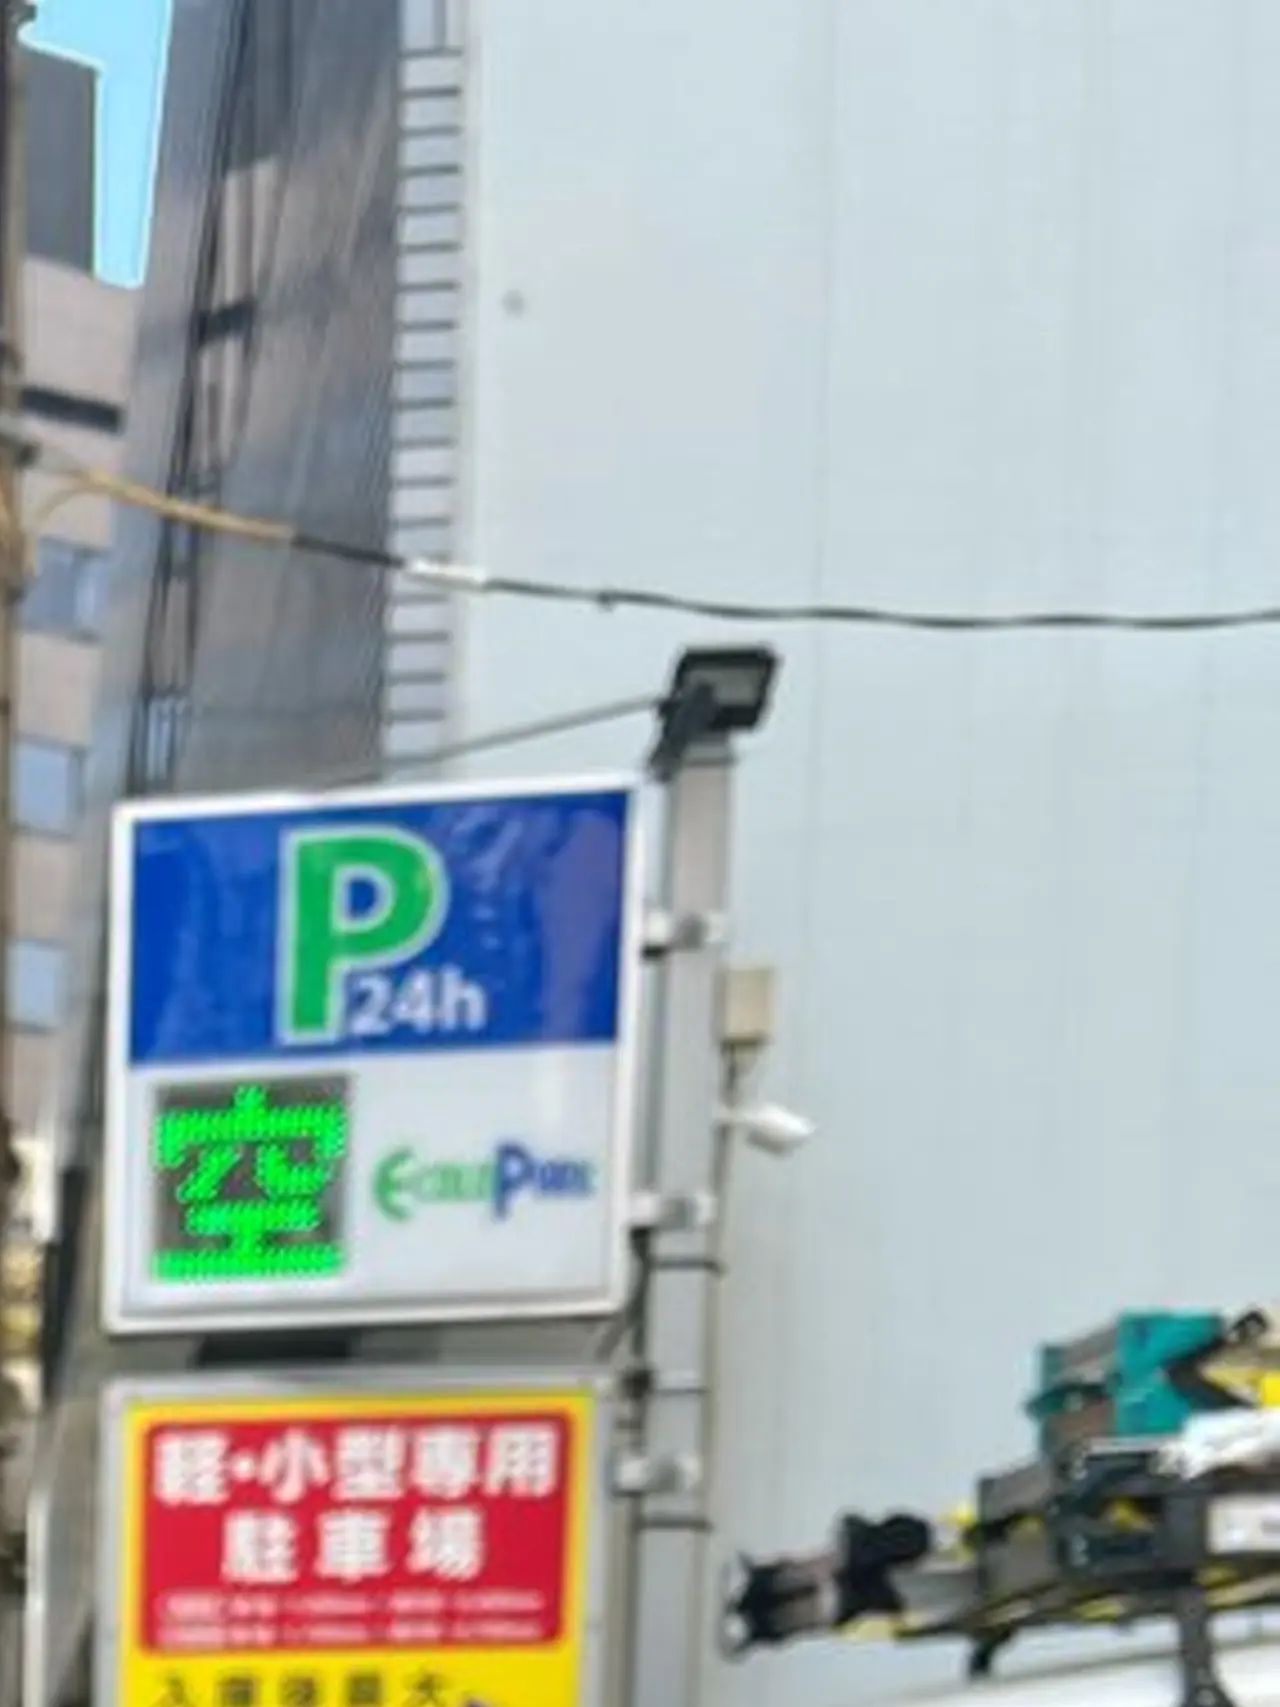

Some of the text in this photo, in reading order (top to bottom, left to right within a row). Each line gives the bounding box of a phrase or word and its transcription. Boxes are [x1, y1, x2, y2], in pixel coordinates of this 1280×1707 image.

[274, 821, 450, 1045] P
[350, 964, 488, 1037] 24h
[153, 1082, 349, 1281] 空
[220, 1503, 486, 1584] 駐車場
